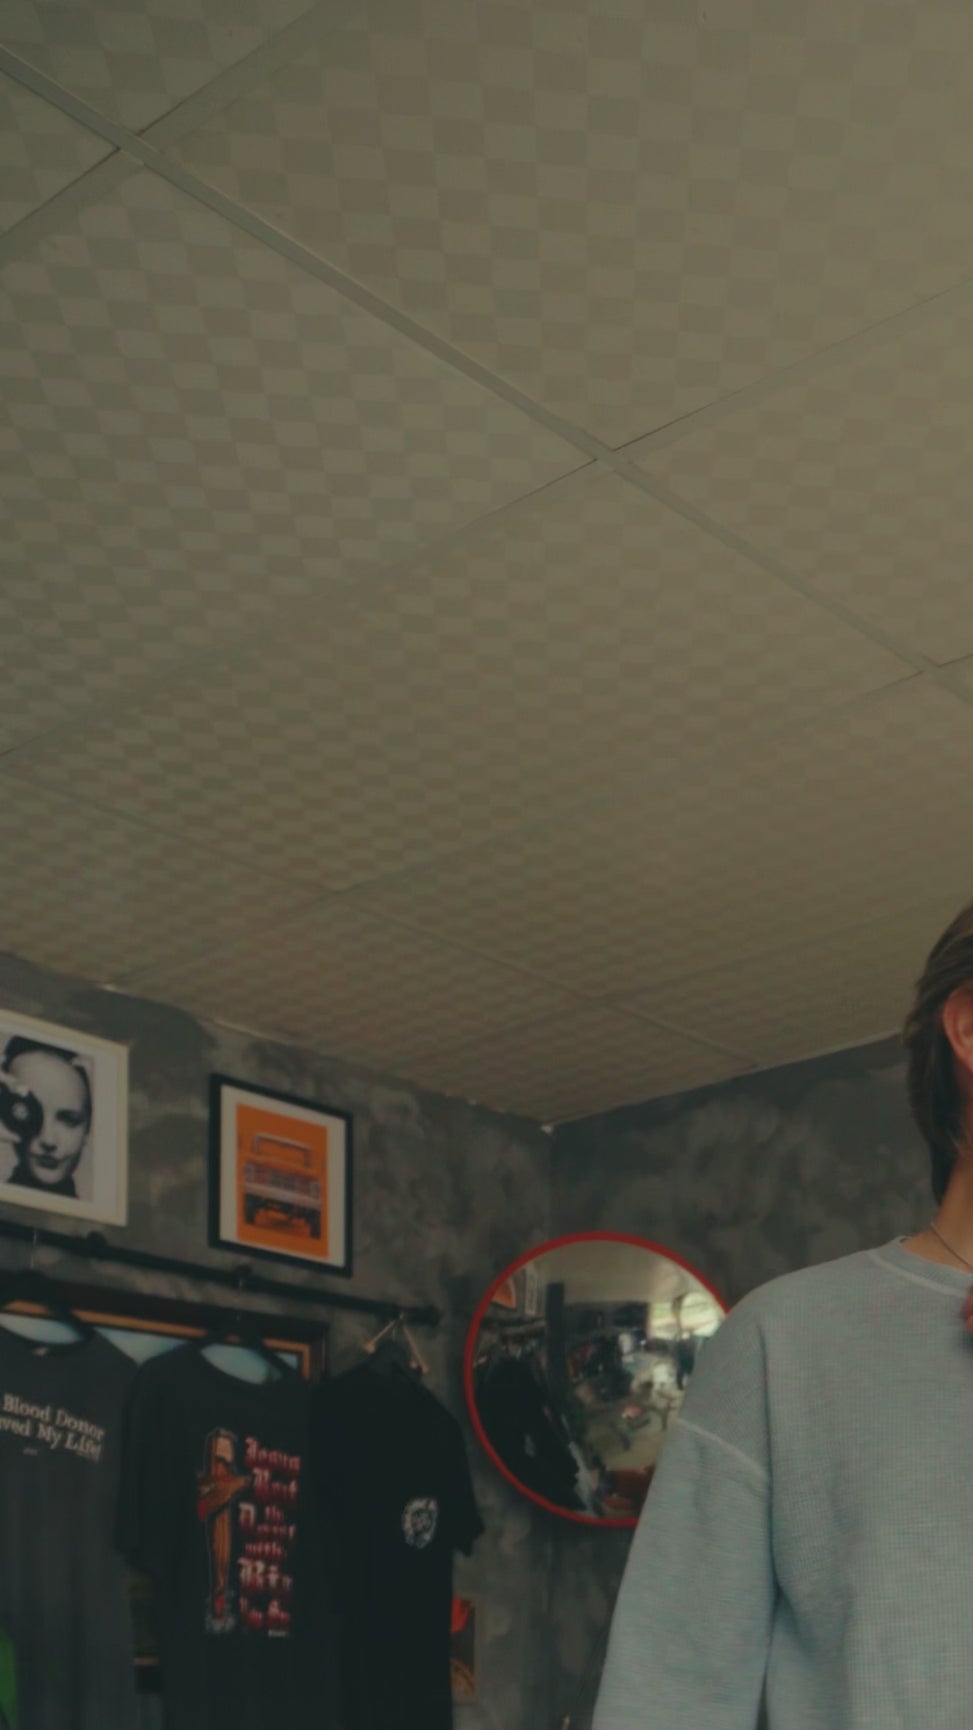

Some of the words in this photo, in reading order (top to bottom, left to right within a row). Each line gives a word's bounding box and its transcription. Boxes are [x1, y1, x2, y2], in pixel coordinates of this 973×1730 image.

[0, 1417, 31, 1437] ved
[36, 1423, 64, 1450] My
[3, 1393, 51, 1422] Blood
[55, 1409, 105, 1441] Donor
